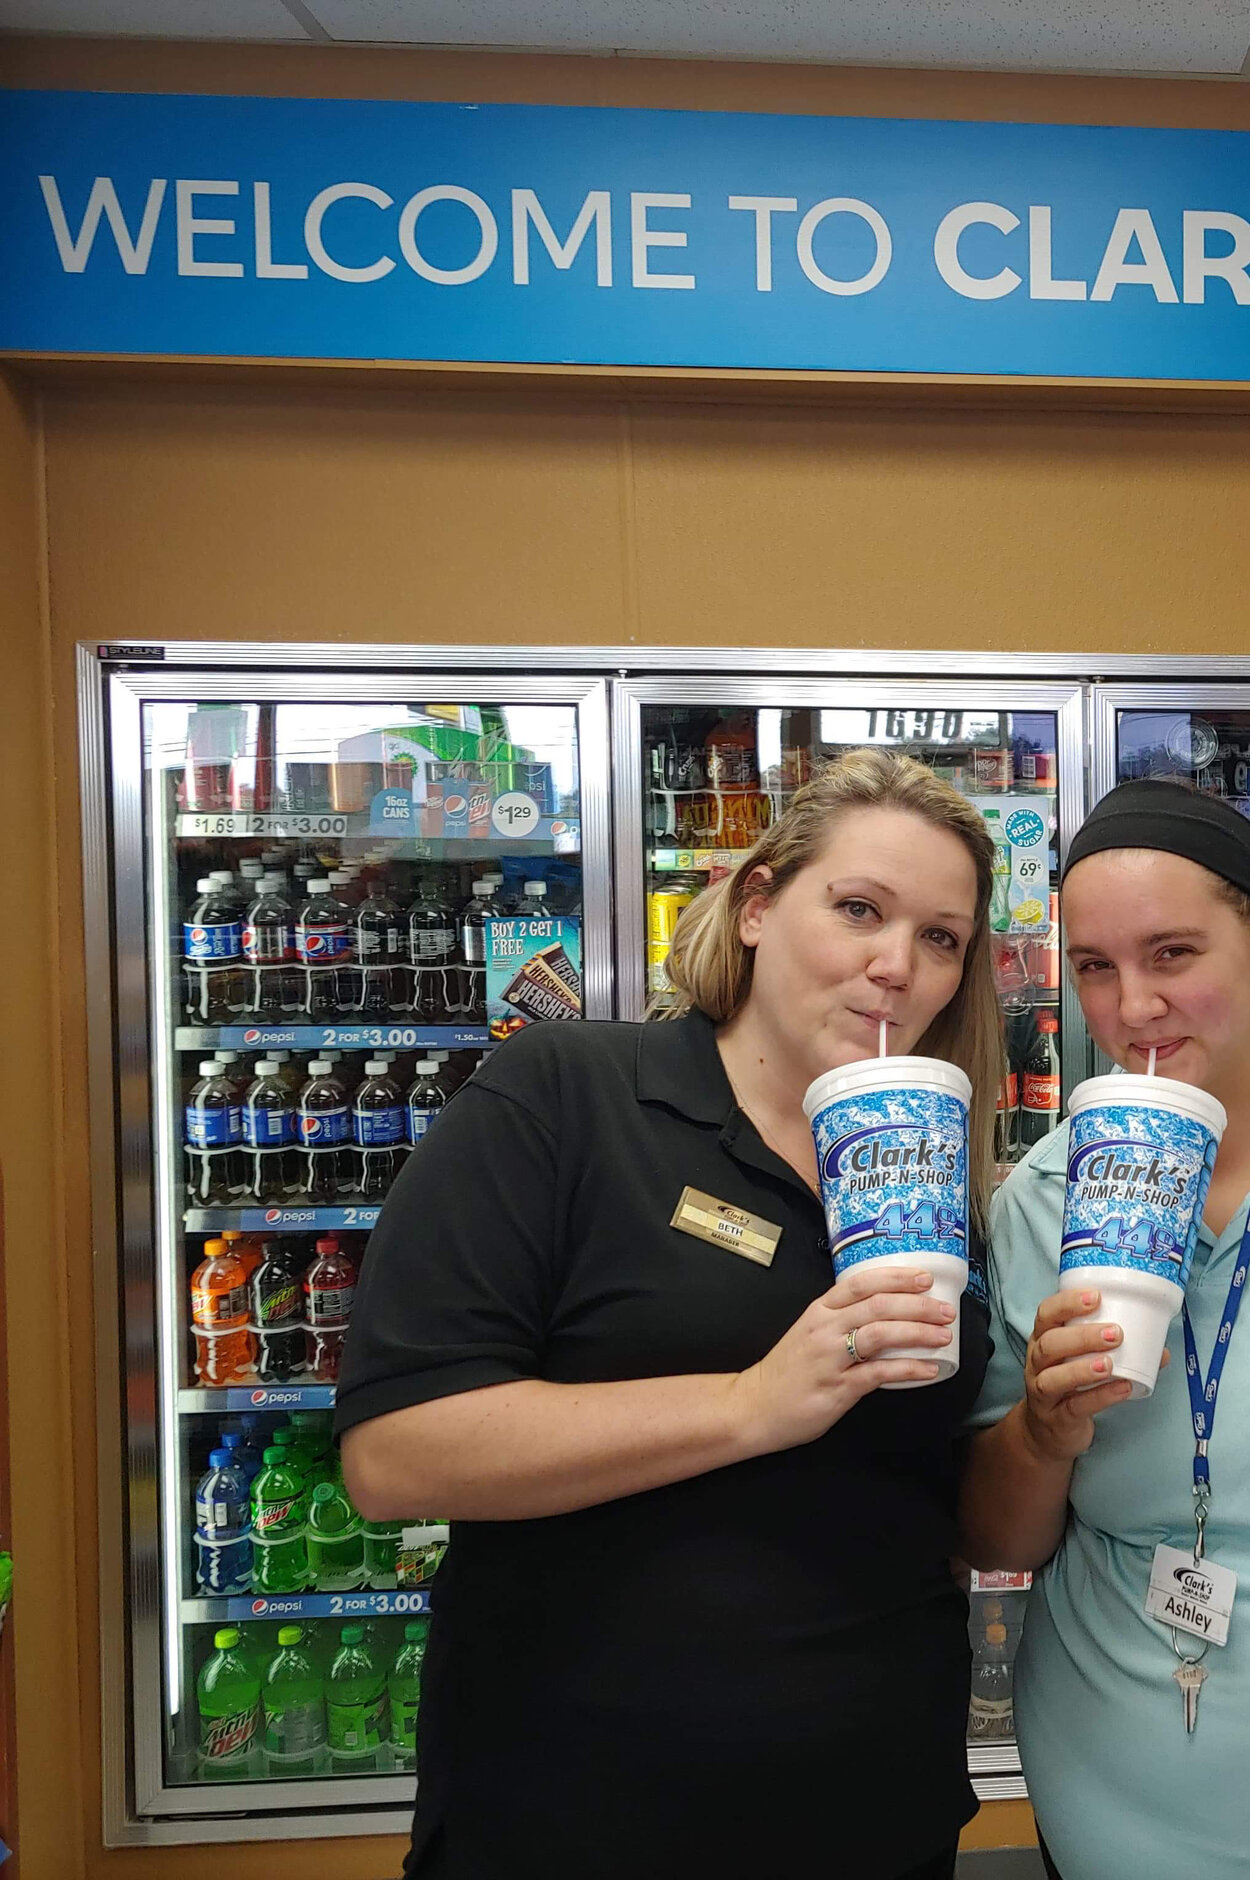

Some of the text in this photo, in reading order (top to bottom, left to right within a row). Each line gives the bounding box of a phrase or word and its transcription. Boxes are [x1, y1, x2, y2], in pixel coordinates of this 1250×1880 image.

[38, 174, 696, 291] WELCOME
[729, 195, 893, 298] TO
[384, 795, 408, 807] 16oz
[382, 807, 411, 819] CANS
[195, 817, 235, 834] $1.69
[252, 817, 346, 834] 2 FOR $3.00
[1010, 819, 1039, 840] REAL
[1017, 829, 1043, 848] SUGAR
[491, 921, 516, 938] BUY
[519, 921, 527, 936] 2
[556, 921, 562, 937] 1
[491, 939, 525, 956] FREE
[261, 1029, 417, 1046] pepsi 2 FOR $3.00
[851, 1138, 957, 1173] Clark's
[849, 1168, 953, 1195] PUMP-N-SHOP
[1086, 1153, 1189, 1195] Clark's
[1080, 1184, 1180, 1210] PUMP-N-SHOP
[282, 1211, 316, 1224] pepsi
[343, 1207, 357, 1225] 2
[718, 1221, 744, 1237] BETH
[268, 1391, 302, 1404] pepsi
[1184, 1575, 1214, 1595] Clark's
[269, 1594, 424, 1614] pepsi 2 FOR $3.00
[1164, 1596, 1212, 1633] Ashley
